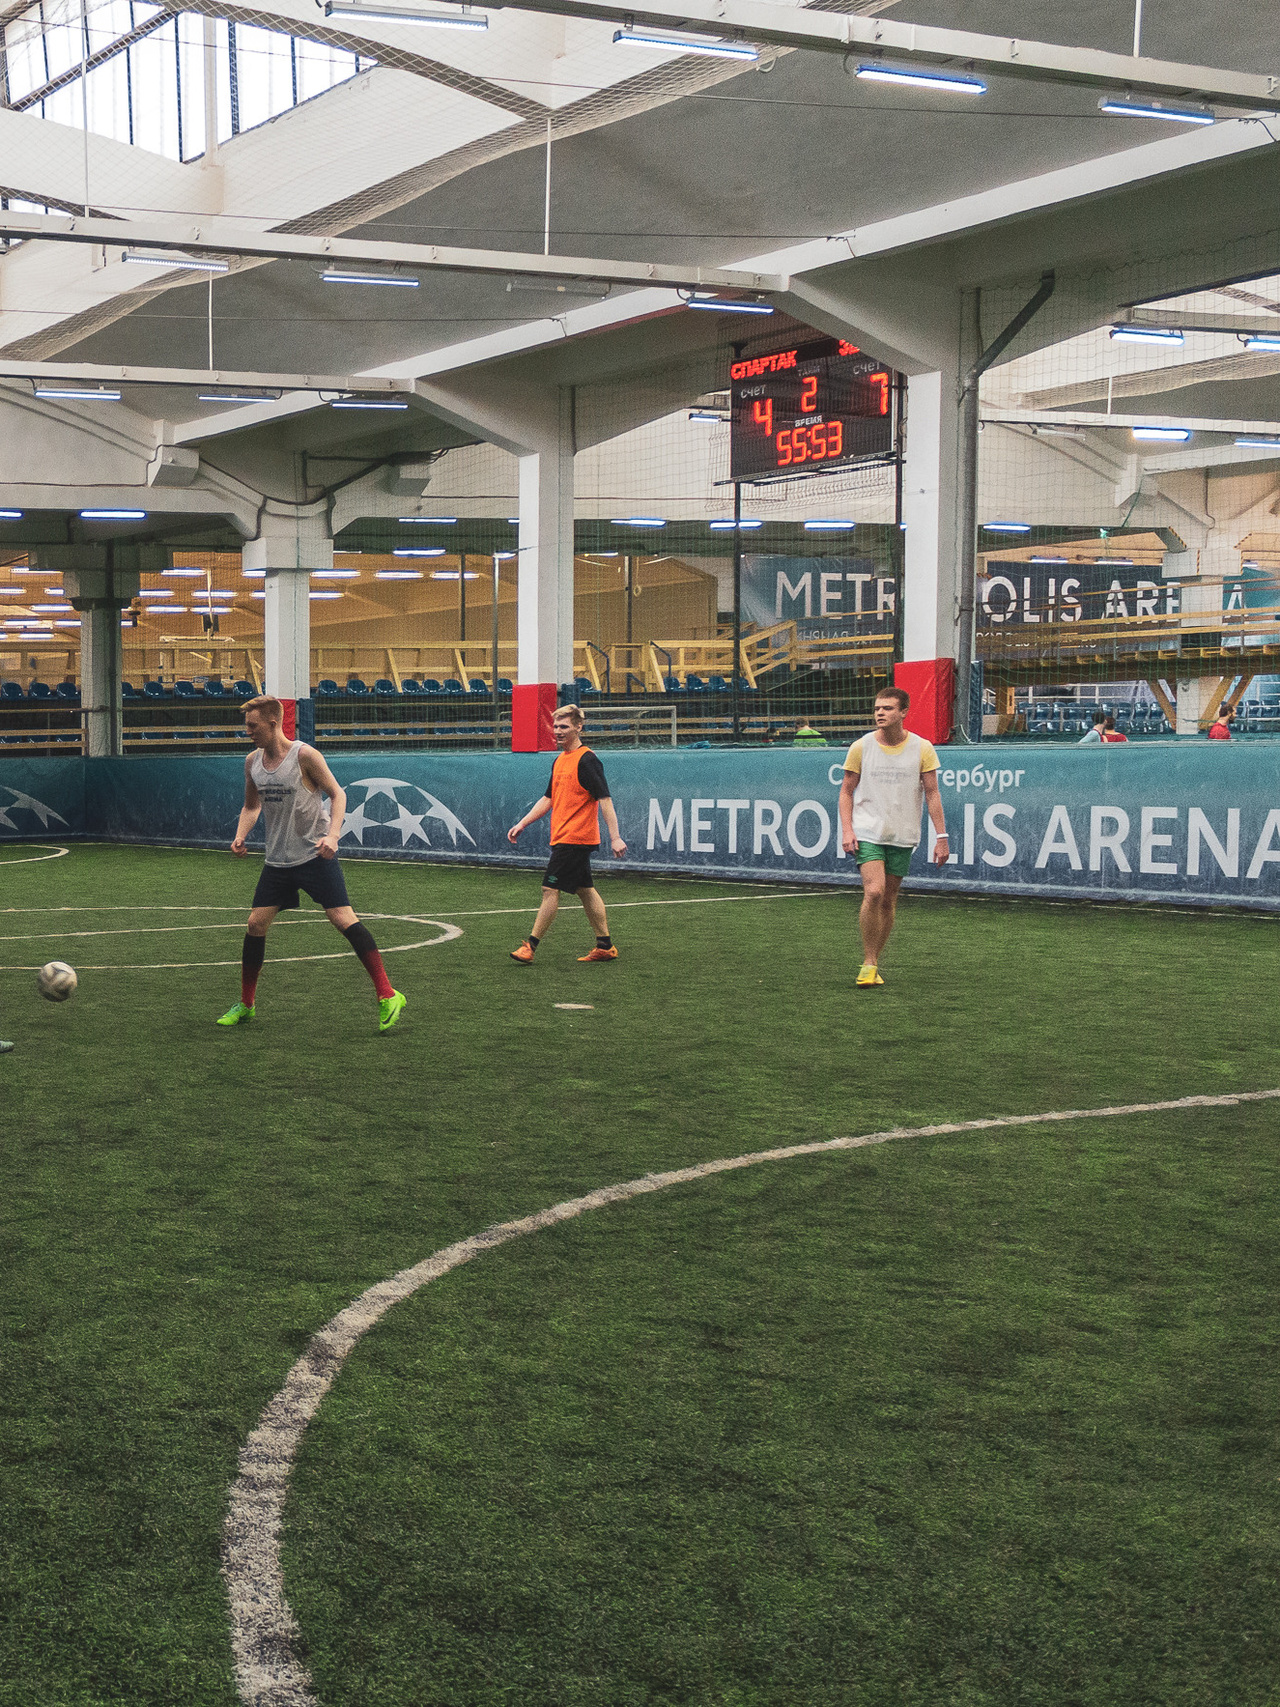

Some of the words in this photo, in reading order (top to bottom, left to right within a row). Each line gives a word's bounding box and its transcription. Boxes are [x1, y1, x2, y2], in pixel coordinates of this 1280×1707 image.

[731, 350, 797, 380] СПАРТАК
[801, 375, 818, 413] 2
[870, 372, 889, 415] 7
[753, 398, 773, 437] 4
[776, 420, 843, 466] 55:53
[775, 571, 1083, 623] METROLIS
[1100, 579, 1248, 625] AREA
[646, 798, 1017, 868] METROLIS
